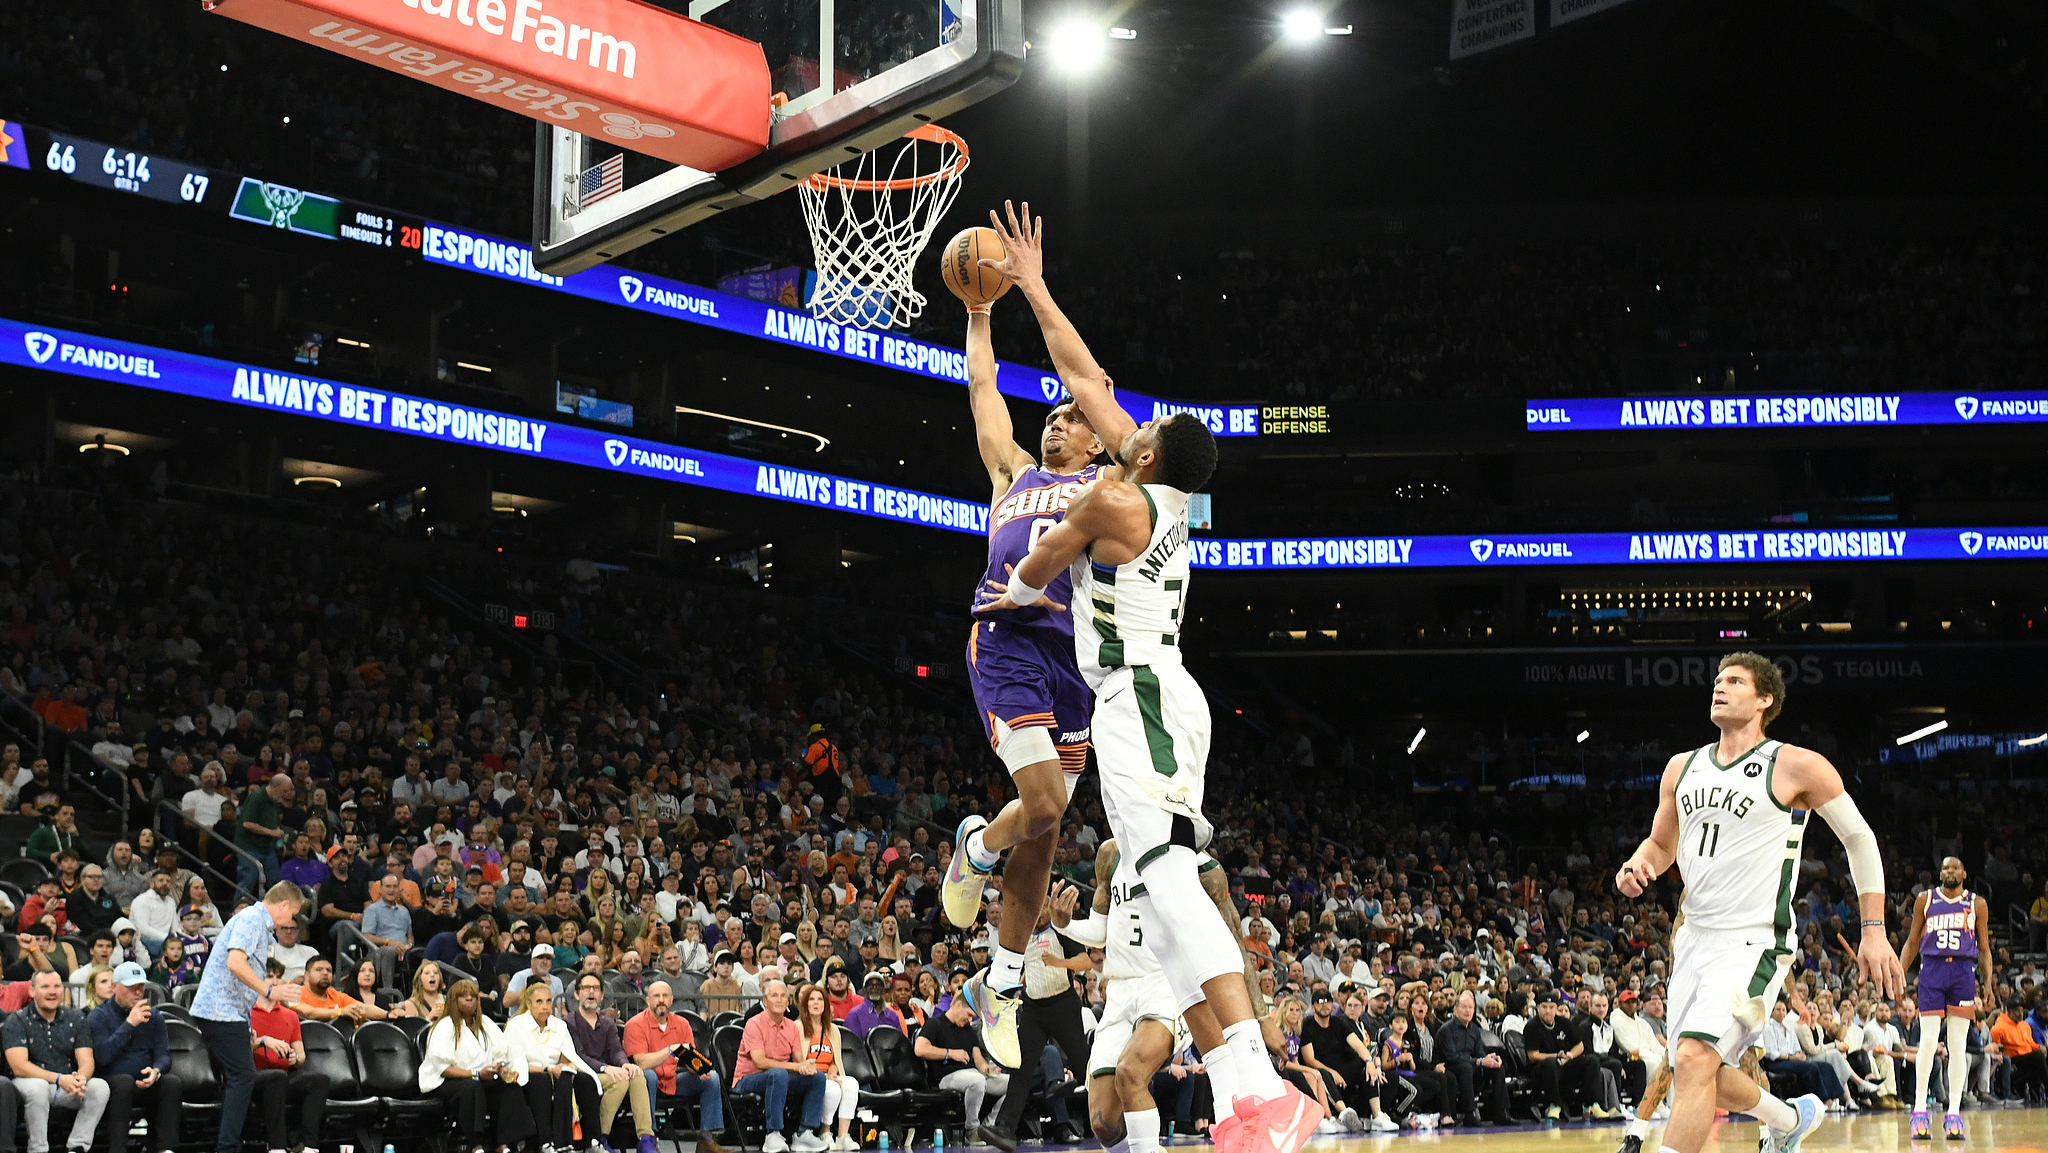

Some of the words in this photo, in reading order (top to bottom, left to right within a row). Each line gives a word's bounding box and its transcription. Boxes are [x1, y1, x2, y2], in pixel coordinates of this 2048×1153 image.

[1460, 18, 1524, 49] CHAMPIONS
[47, 142, 76, 174] 66
[103, 148, 150, 182] 6:14
[180, 173, 209, 203] 67
[341, 225, 382, 245] TIMEOUTS
[356, 211, 383, 229] FOULS
[386, 219, 393, 231] 3
[400, 226, 421, 249] 20
[645, 286, 719, 319] FANDUEL
[763, 308, 840, 352] ALWAYS
[845, 325, 880, 359] BET
[60, 343, 160, 379] FANDUEL
[231, 367, 334, 415] ALWAYS
[339, 387, 387, 424] BET
[391, 396, 547, 453] RESPONSIBLY
[1263, 406, 1331, 419] DEFENSE.
[1620, 399, 1705, 426] ALWAYS
[1710, 398, 1750, 425] BET
[1754, 396, 1900, 424] RESPONSIBLY
[1263, 420, 1331, 434] DEFENSE.
[630, 448, 704, 477] FANDUEL
[756, 465, 831, 504] ALWAYS
[835, 480, 870, 511] BET
[873, 487, 990, 533] RESPONSIBLY
[1227, 541, 1267, 566] BET
[1271, 538, 1413, 565] RESPONSIBLY
[1496, 542, 1572, 558] FANDUEL
[1629, 535, 1713, 561] ALWAYS
[1718, 533, 1759, 560] BET
[1762, 531, 1907, 559] RESPONSIBLY
[514, 615, 528, 628] EXIT
[1525, 665, 1564, 681] 100%
[1568, 664, 1615, 681] AGAVE
[1832, 660, 1923, 679] TEQUILA
[1681, 786, 1754, 819] BUCKS
[1698, 822, 1720, 858] 11
[1927, 912, 1965, 933] SUNS
[1936, 929, 1961, 951] 35
